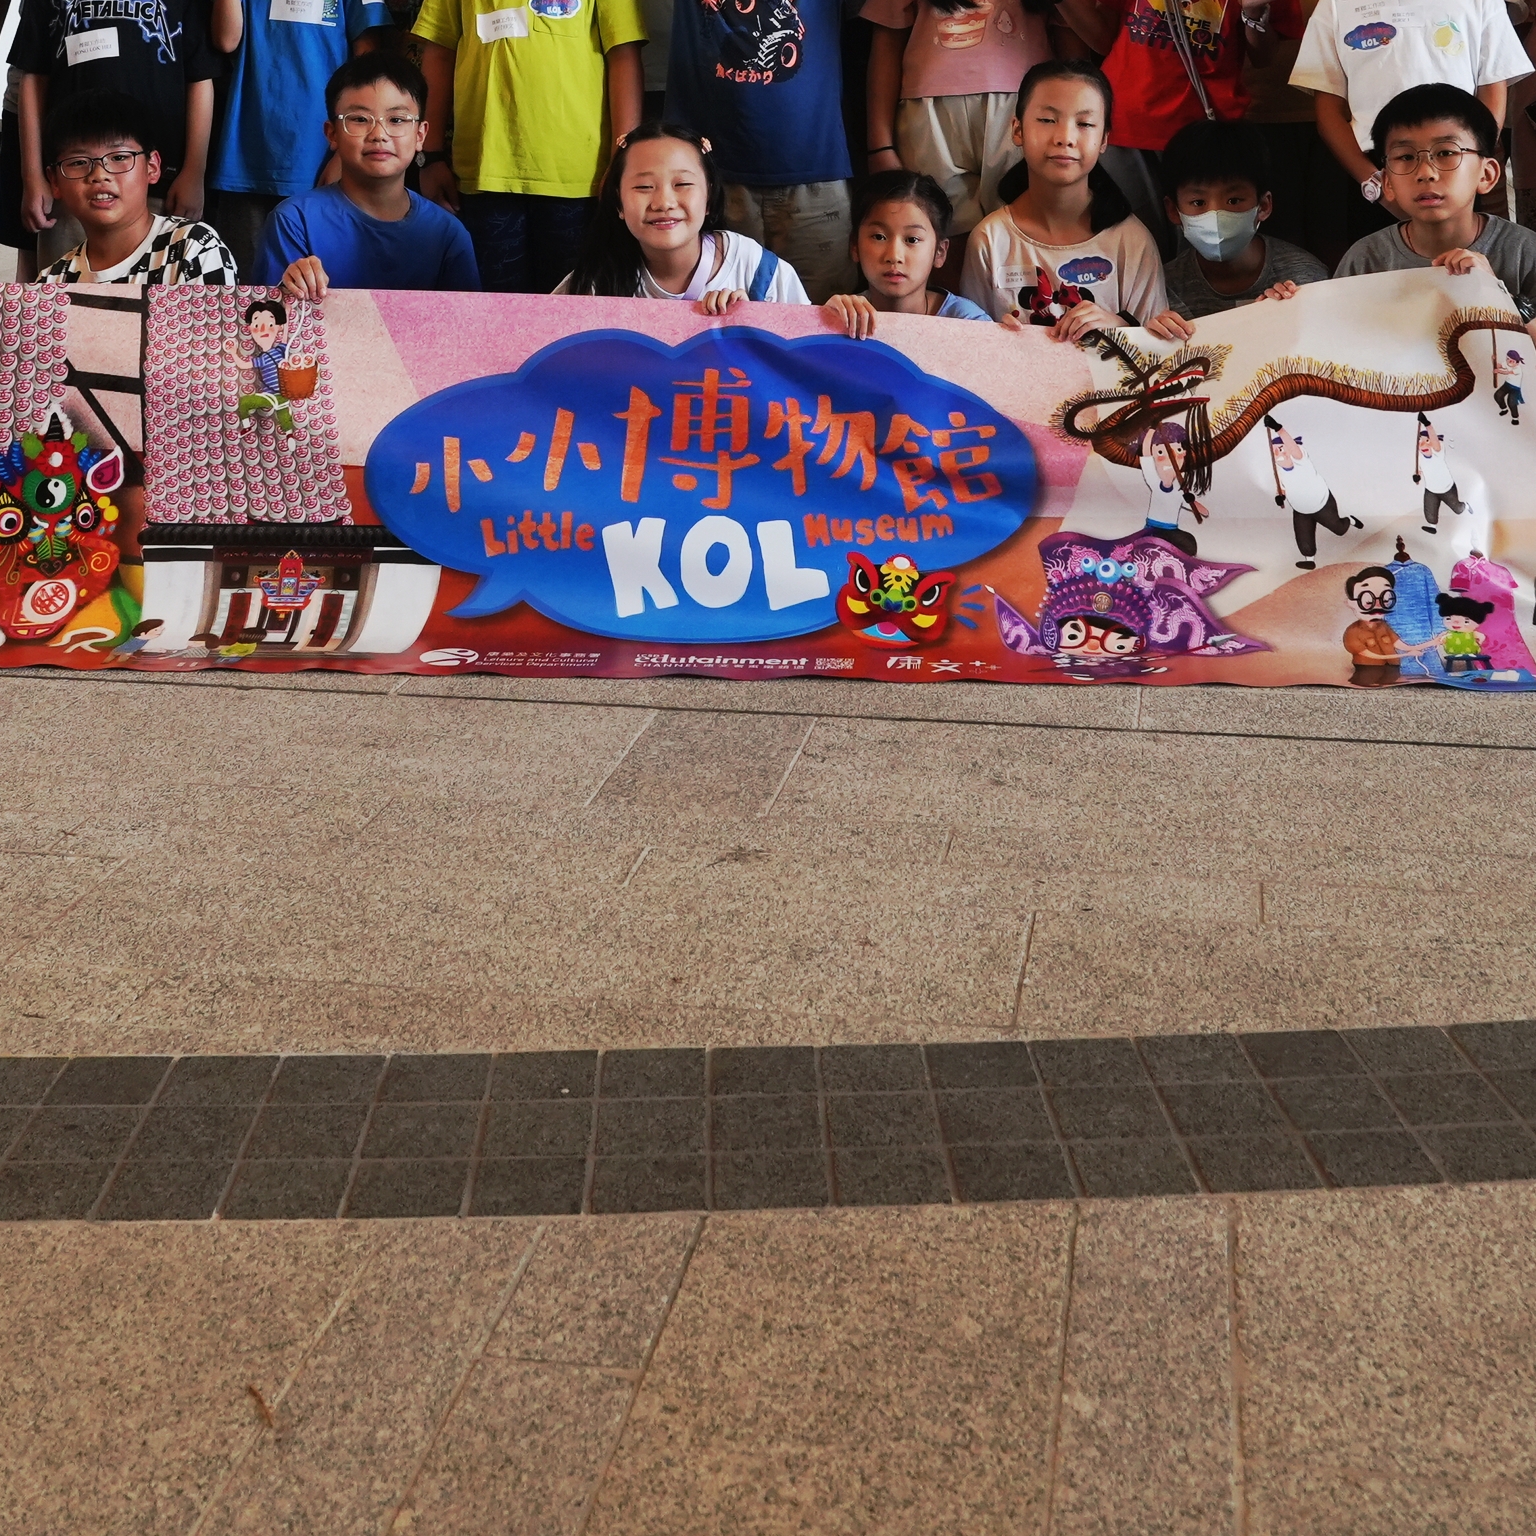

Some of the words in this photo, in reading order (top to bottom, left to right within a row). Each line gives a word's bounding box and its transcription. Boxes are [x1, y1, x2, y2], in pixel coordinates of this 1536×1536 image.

[1361, 37, 1380, 48] KOL
[1076, 272, 1096, 283] KOL
[408, 368, 1004, 516] 小小博物館
[479, 510, 595, 559] Little
[802, 511, 955, 551] Museum
[600, 514, 831, 619] KOL
[526, 661, 596, 669] Department
[634, 654, 809, 665] edutainment
